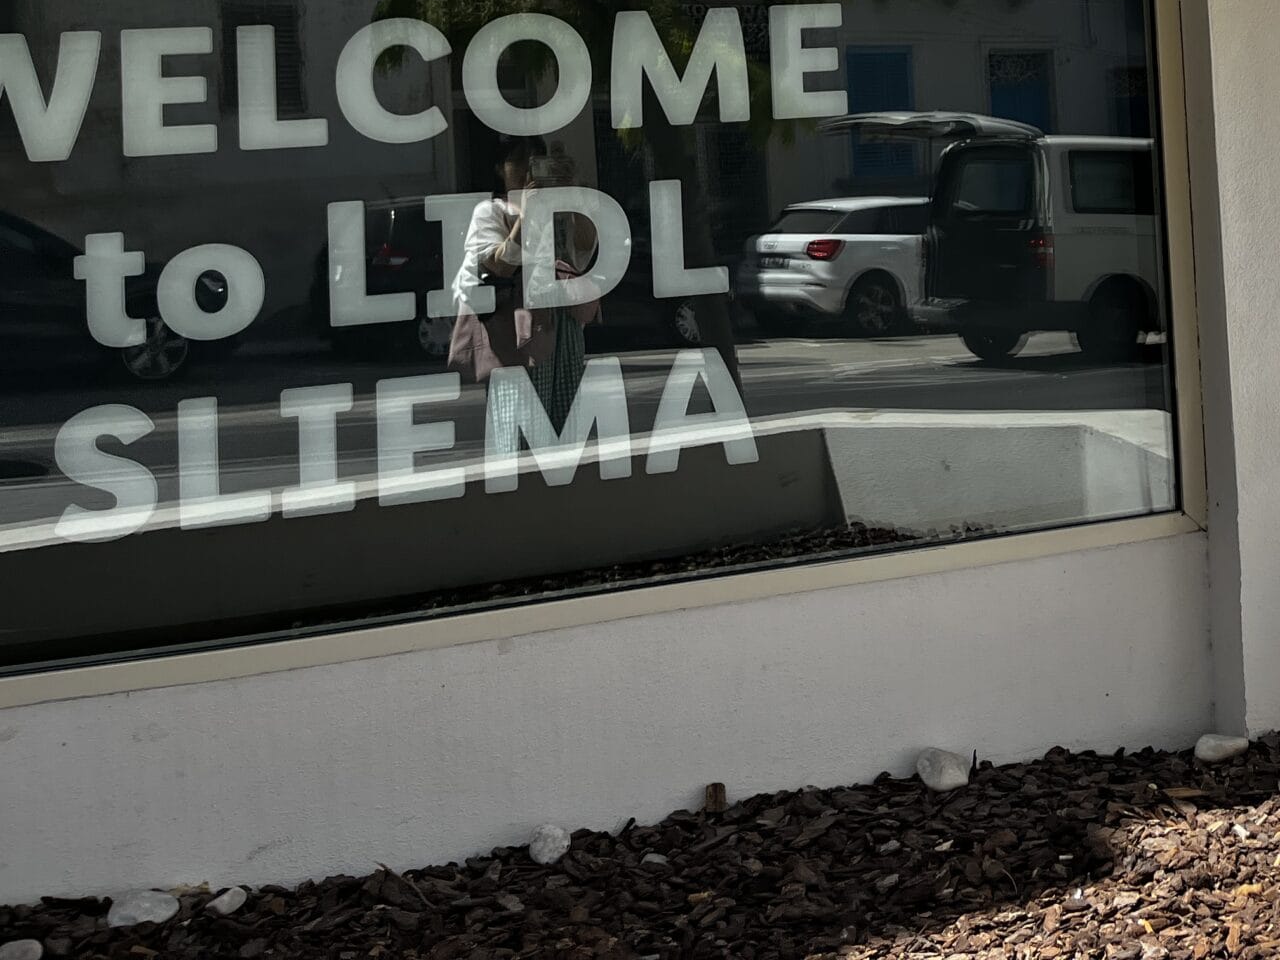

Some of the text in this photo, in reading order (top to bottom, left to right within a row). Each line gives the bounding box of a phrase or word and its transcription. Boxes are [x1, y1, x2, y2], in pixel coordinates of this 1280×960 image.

[74, 179, 729, 348] to LIDL
[54, 348, 760, 543] SLIEMA
